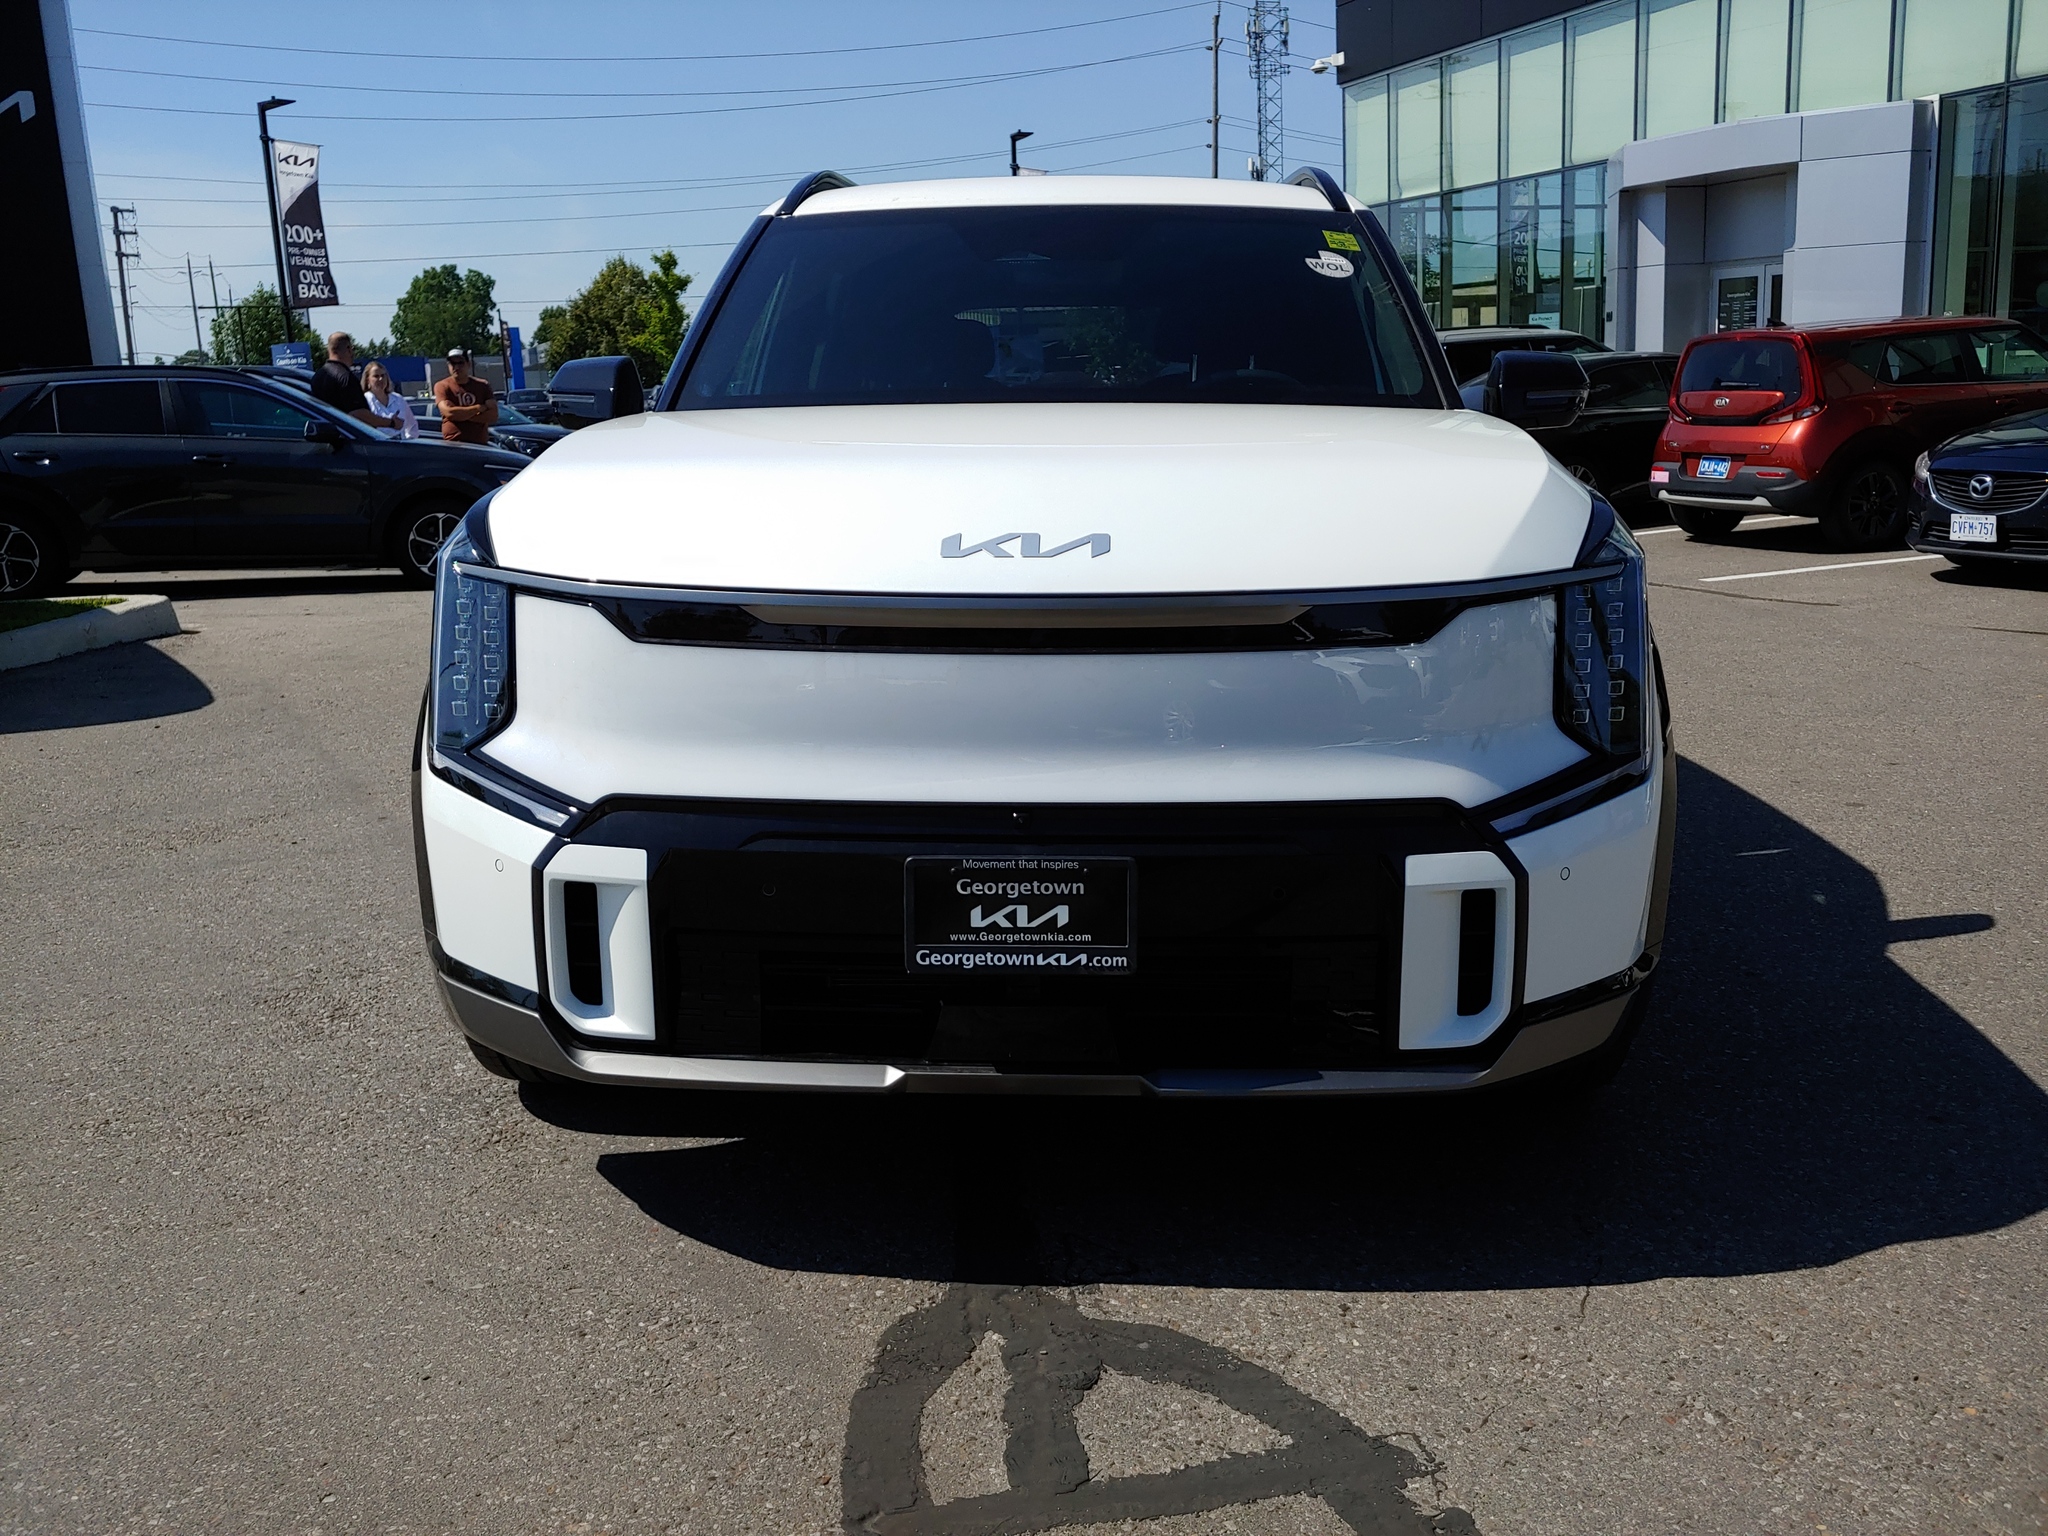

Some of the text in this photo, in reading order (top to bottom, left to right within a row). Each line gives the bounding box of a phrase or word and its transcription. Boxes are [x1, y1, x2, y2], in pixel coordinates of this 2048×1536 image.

[278, 152, 315, 168] KIA
[285, 224, 324, 244] 200+
[290, 256, 328, 268] VEHICLES
[299, 269, 325, 285] OUT
[298, 284, 335, 298] BACK
[940, 532, 1111, 558] KIA
[962, 859, 1079, 871] Movement that inspires
[956, 878, 1085, 898] Georgetown
[970, 904, 1069, 928] KIA
[949, 932, 1092, 944] www.Georgetownkia.com
